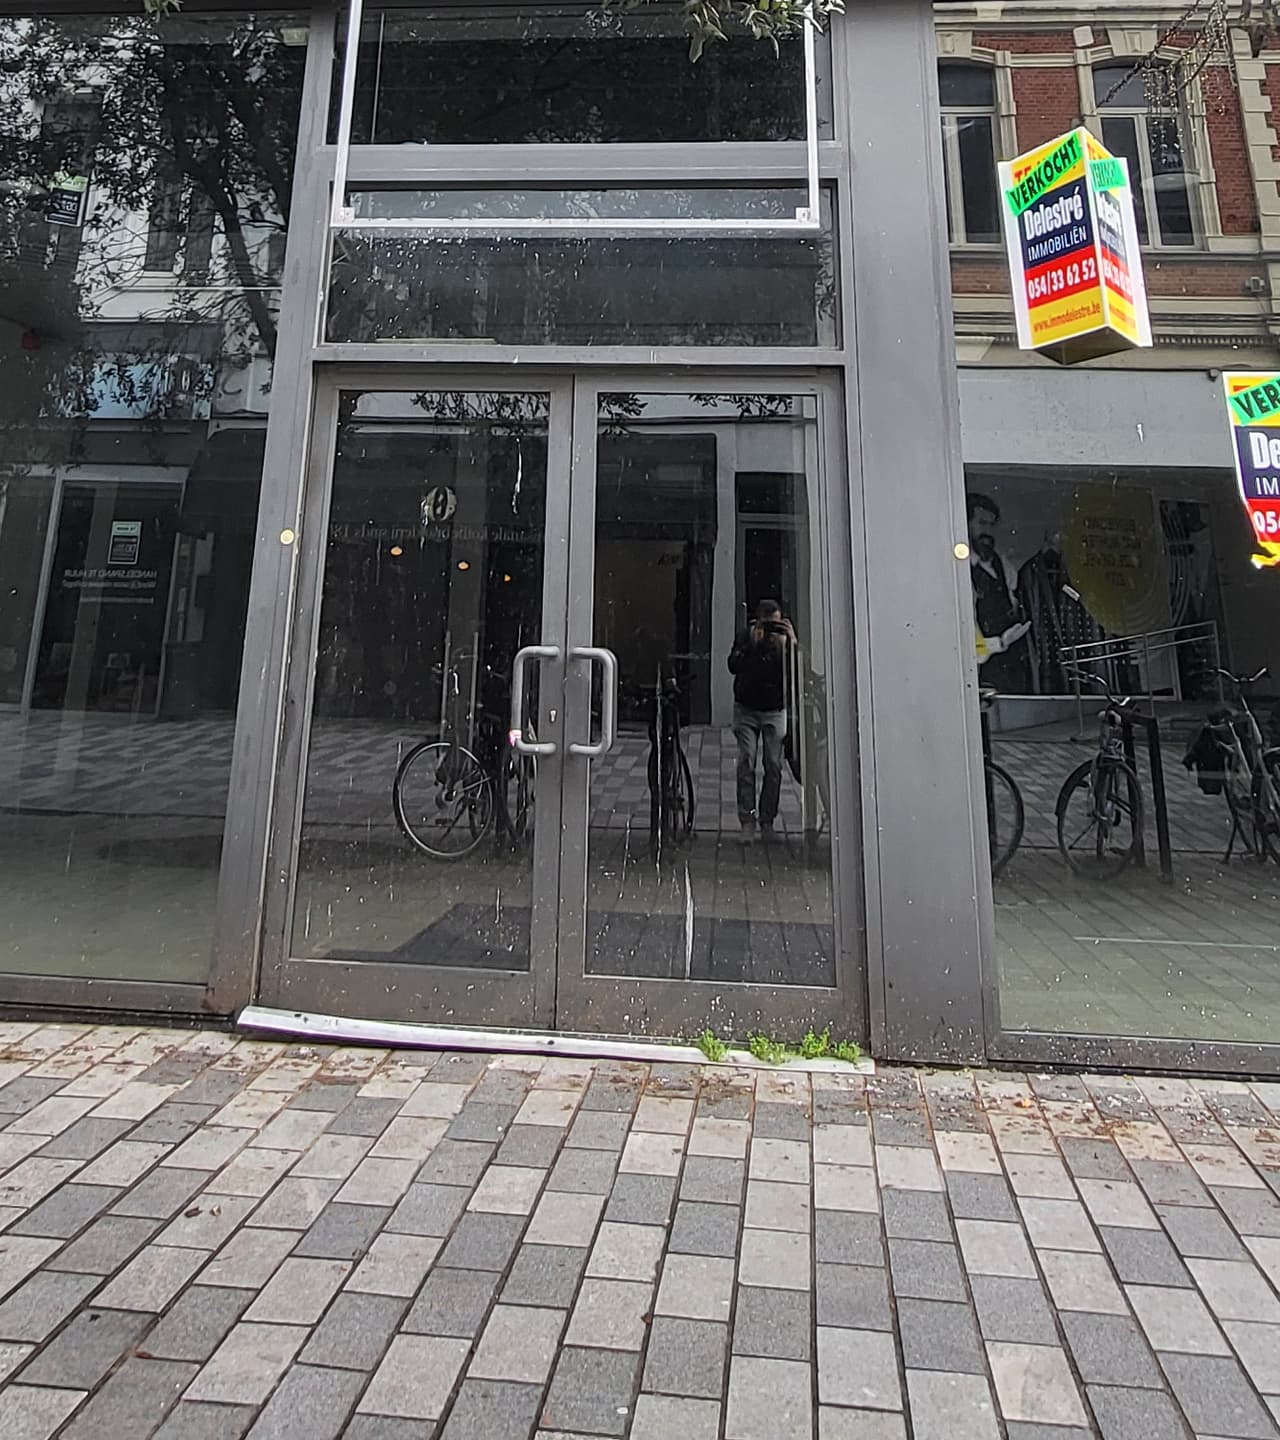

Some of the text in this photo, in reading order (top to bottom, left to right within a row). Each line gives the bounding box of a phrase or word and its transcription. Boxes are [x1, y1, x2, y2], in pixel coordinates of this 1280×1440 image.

[1008, 137, 1076, 206] VERKOCHT
[1024, 185, 1084, 241] Delestré
[1028, 225, 1087, 262] IMMOBILIËN
[1028, 268, 1064, 299] 054/33
[1067, 264, 1081, 287] 62
[1082, 257, 1096, 280] 52
[1033, 302, 1100, 333] www.immodelestre.be
